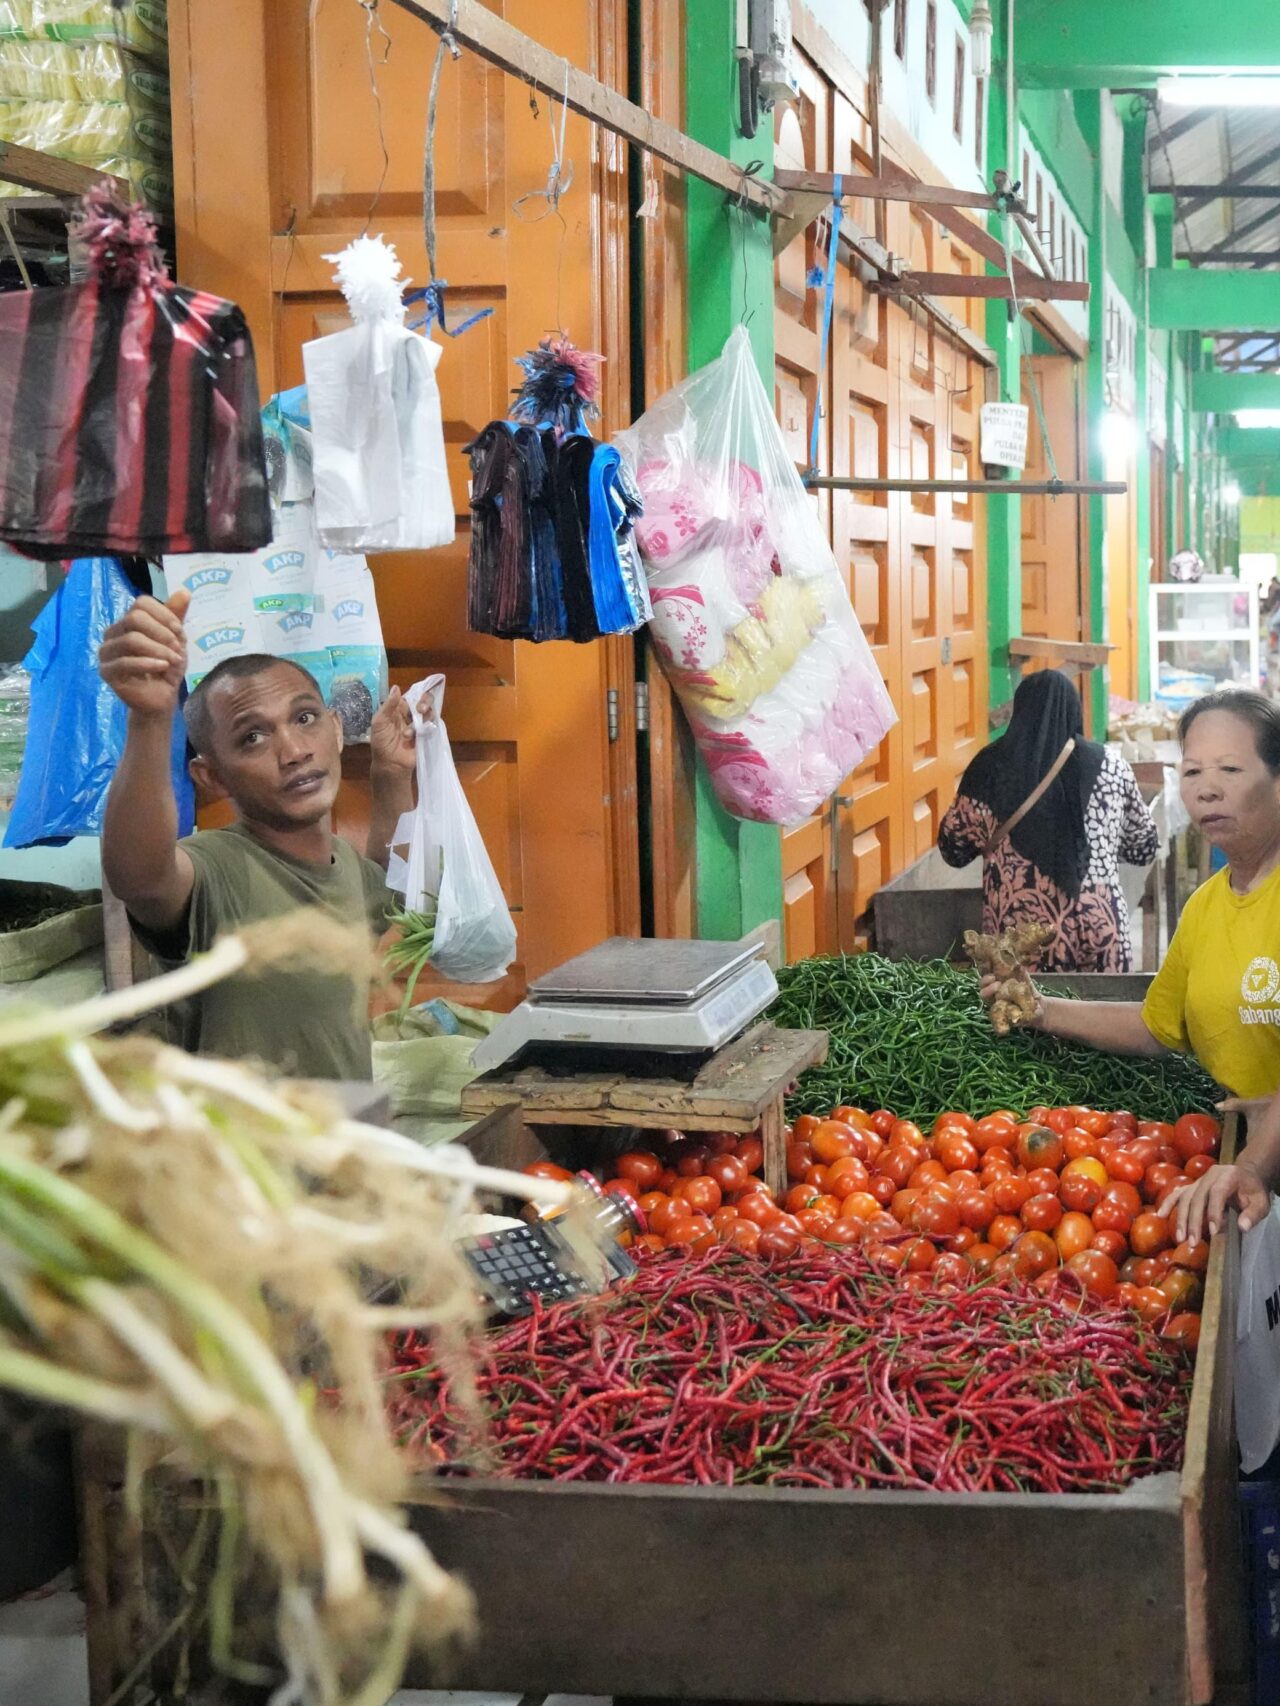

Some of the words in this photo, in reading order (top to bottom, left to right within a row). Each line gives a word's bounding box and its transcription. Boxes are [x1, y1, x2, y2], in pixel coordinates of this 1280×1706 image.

[272, 551, 304, 571] AKP
[191, 570, 228, 589] AKP
[261, 598, 283, 609] AKP
[335, 601, 362, 619] AKP
[286, 611, 312, 629] AKP
[204, 629, 241, 648] AKP
